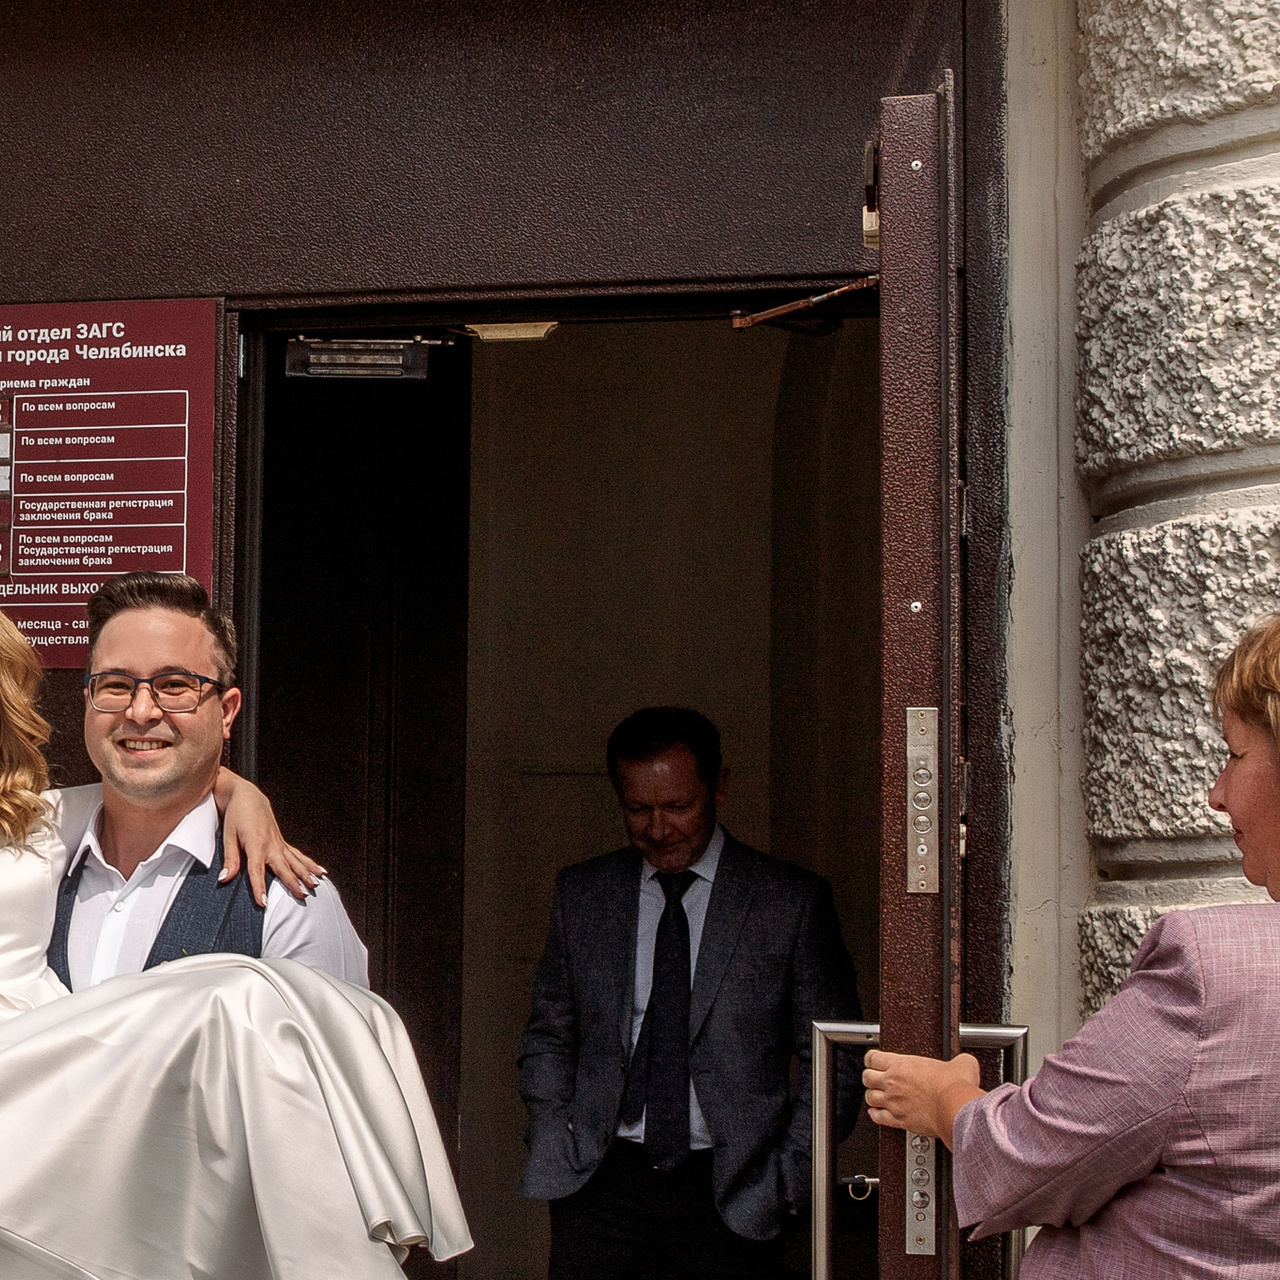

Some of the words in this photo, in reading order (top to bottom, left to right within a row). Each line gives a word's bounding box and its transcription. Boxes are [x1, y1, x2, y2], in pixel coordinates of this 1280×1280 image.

[17, 327, 71, 344] отдел
[76, 322, 125, 339] ЗАГС
[7, 348, 70, 366] города
[75, 342, 187, 360] Челябинска
[39, 377, 91, 390] граждан
[22, 402, 36, 412] По
[38, 402, 63, 412] всем
[65, 401, 116, 413] вопросам
[21, 436, 35, 446] По
[37, 436, 63, 445] всем
[65, 435, 115, 446] вопросам
[20, 473, 34, 483] По
[36, 473, 62, 482] всем
[64, 472, 114, 483] вопросам
[19, 500, 107, 512] Государственная
[108, 498, 174, 510] регистрация
[19, 512, 81, 521] заключения
[83, 510, 114, 522] брака
[19, 534, 33, 544] По
[35, 534, 60, 543] всем
[63, 533, 113, 545] вопросам
[18, 545, 106, 557] Государственная
[108, 544, 173, 555] регистрация
[18, 557, 80, 566] заключения
[82, 555, 113, 567] брака
[61, 582, 104, 594] ВЫХО
[17, 620, 62, 631] месяца
[25, 635, 90, 647] существля
